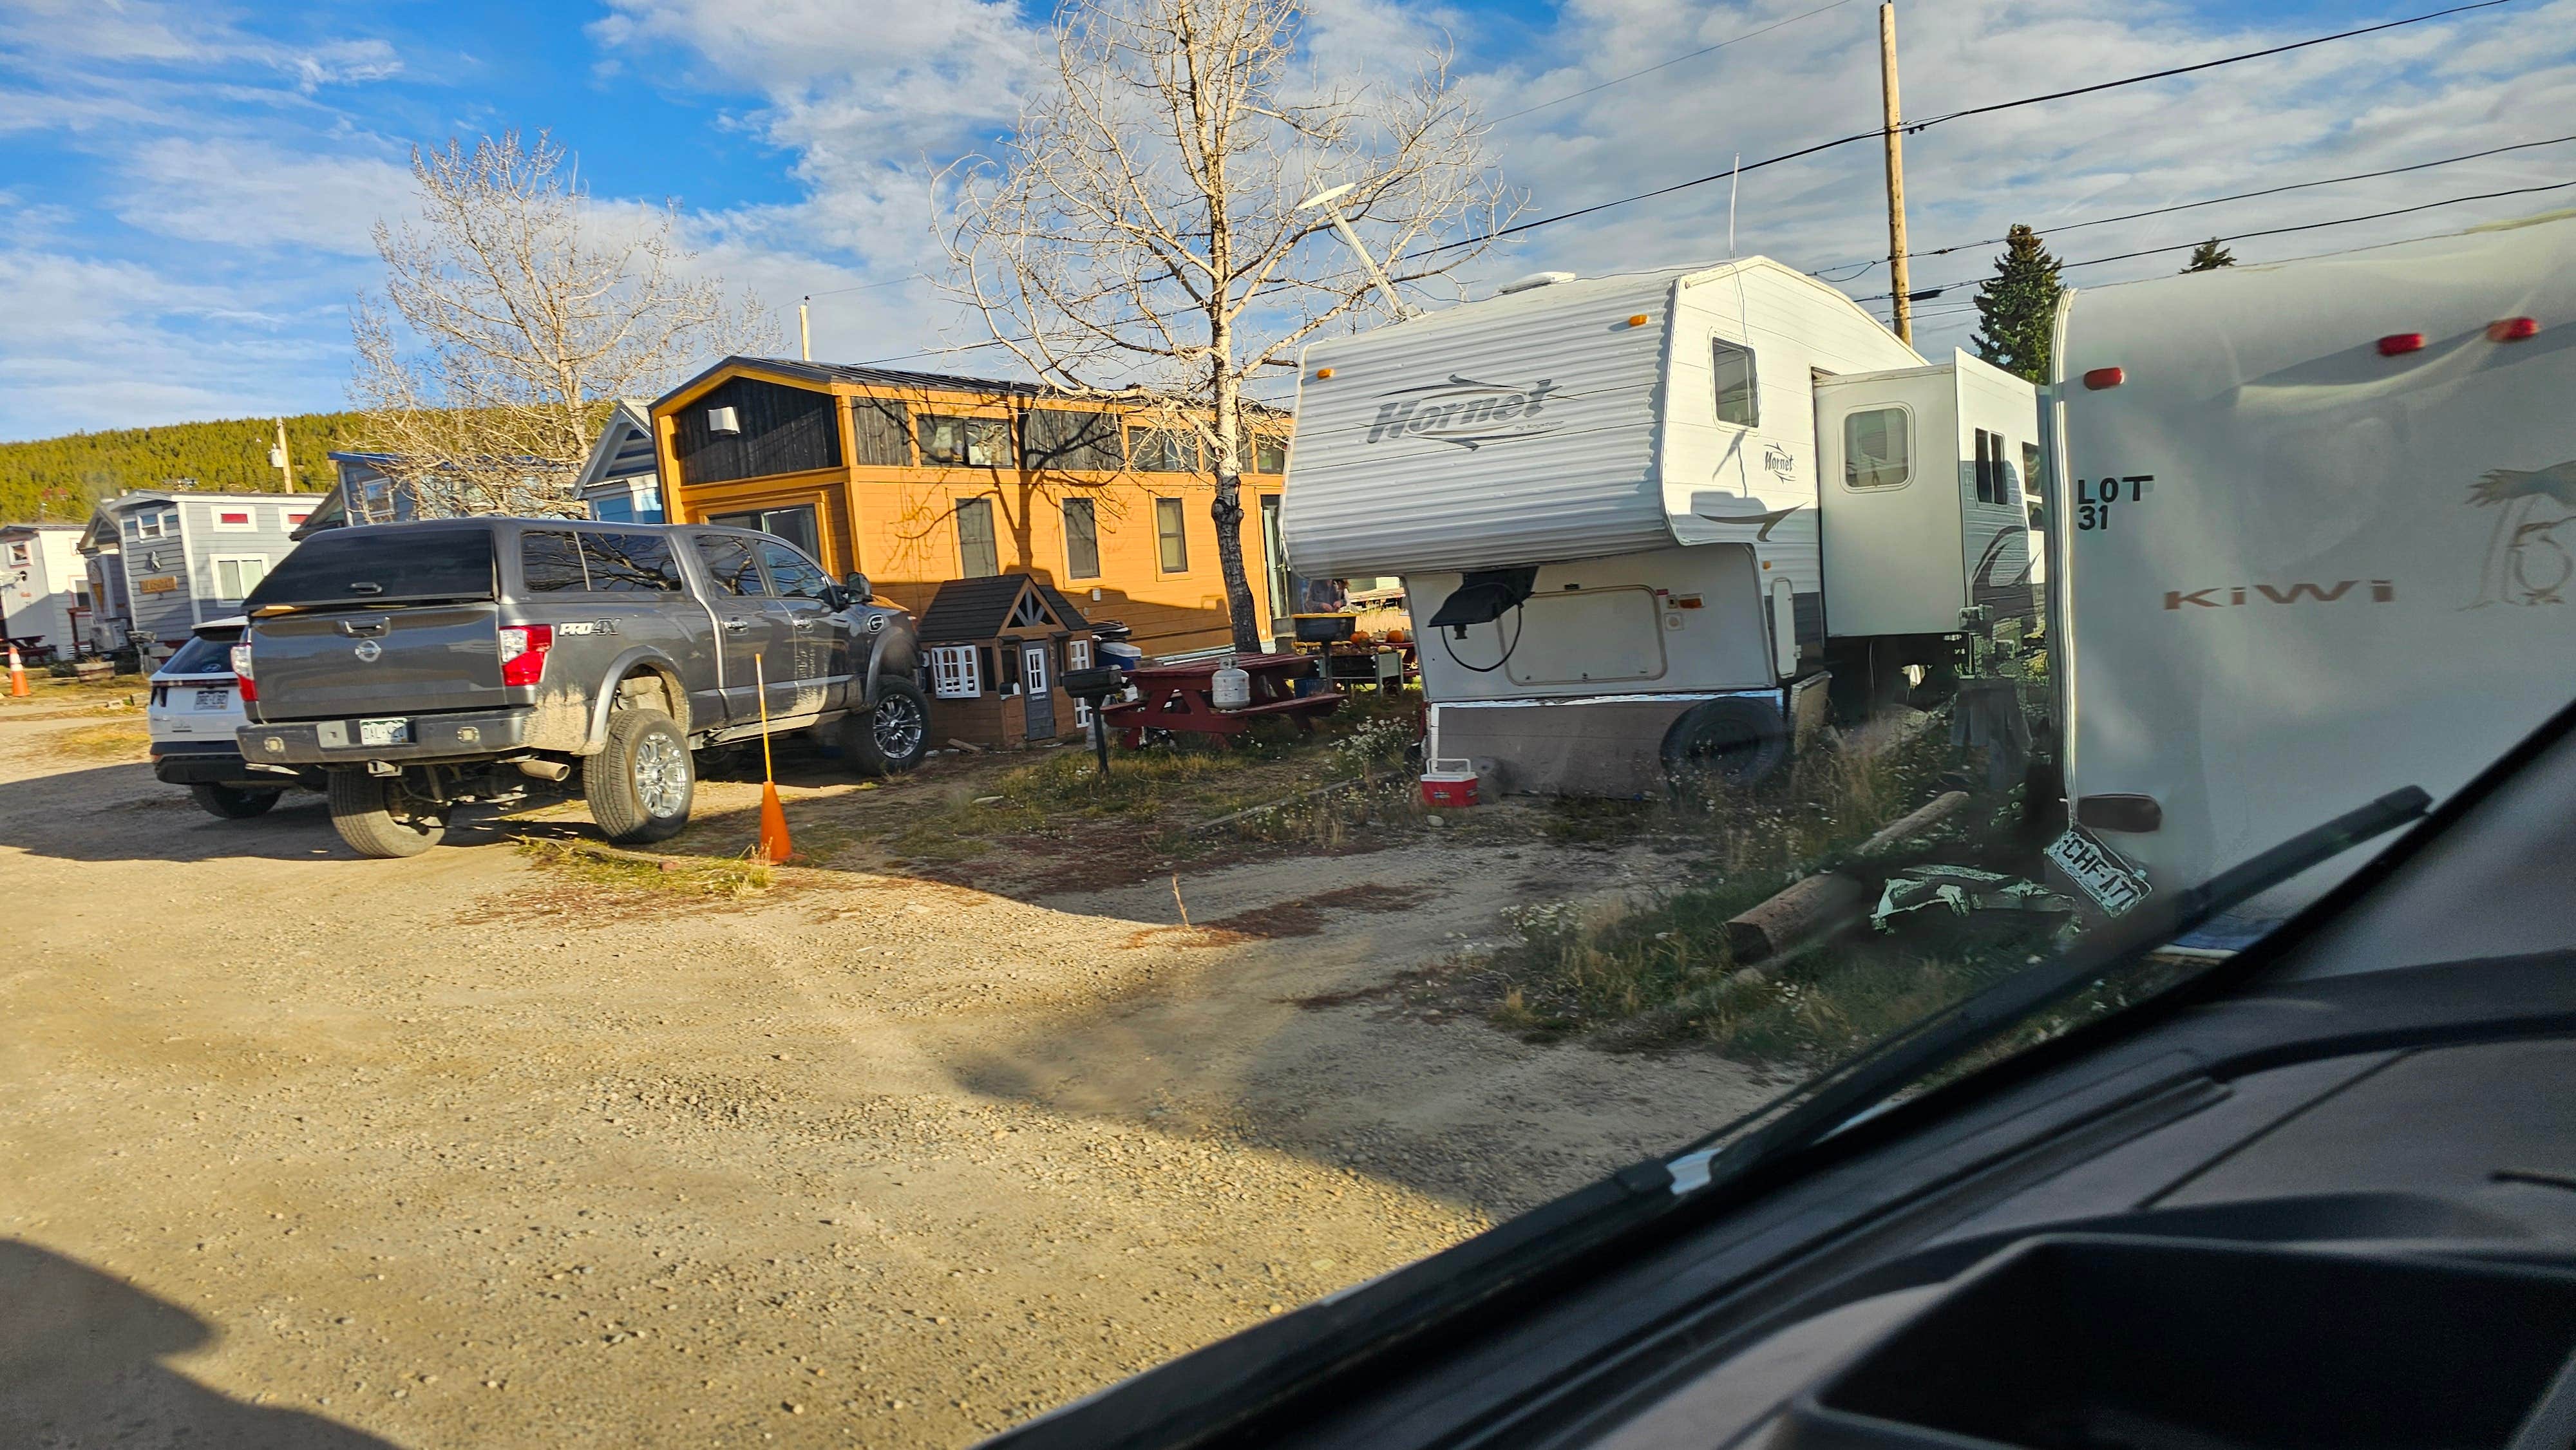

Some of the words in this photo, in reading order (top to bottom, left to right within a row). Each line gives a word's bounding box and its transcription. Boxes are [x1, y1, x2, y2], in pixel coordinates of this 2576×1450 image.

[1367, 379, 1563, 444] Hornet
[1765, 451, 1794, 472] Hornet
[2078, 475, 2154, 504] LOT
[2078, 505, 2108, 531] 31
